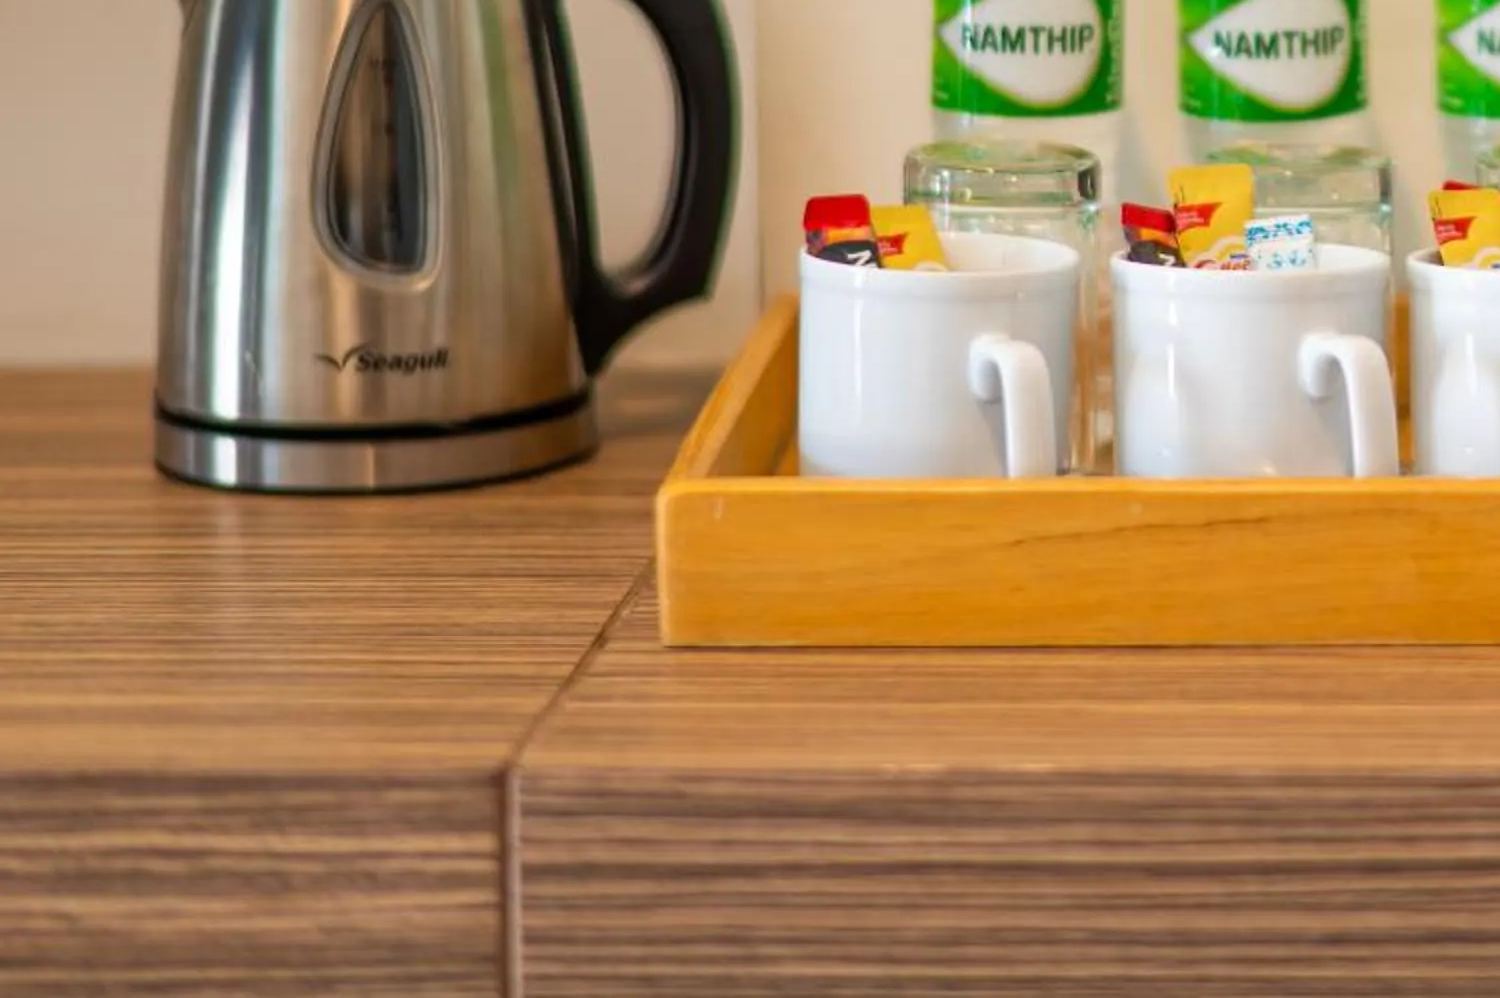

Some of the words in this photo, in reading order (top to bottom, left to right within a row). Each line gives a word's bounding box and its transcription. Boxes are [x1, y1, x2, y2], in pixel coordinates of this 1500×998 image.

[961, 23, 1095, 55] NAMTHIP
[1213, 26, 1345, 59] NAMTHIP
[356, 348, 450, 377] Seagull
